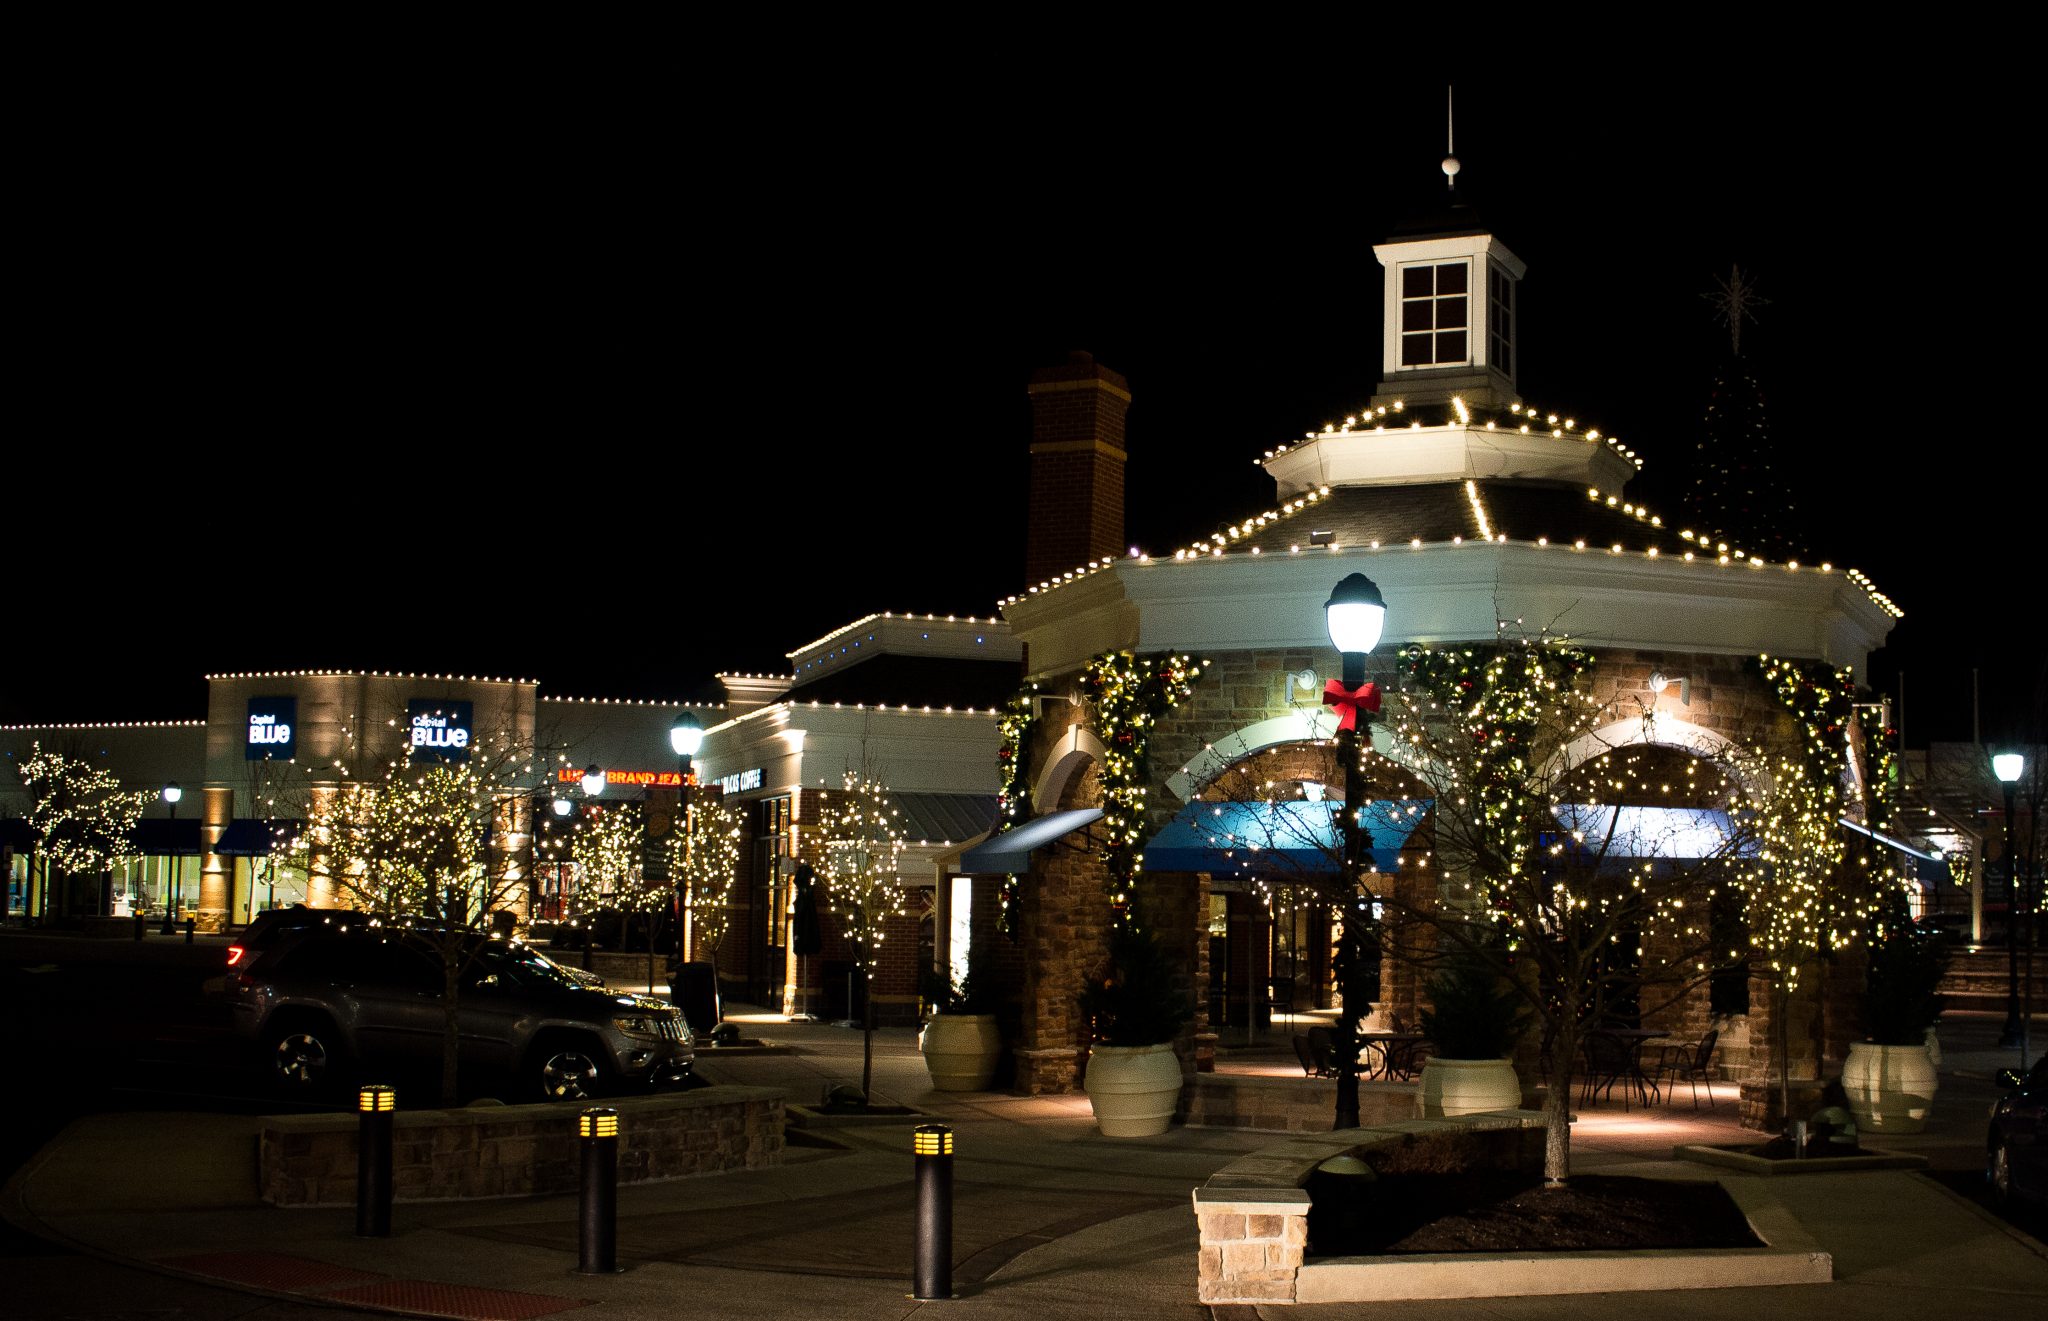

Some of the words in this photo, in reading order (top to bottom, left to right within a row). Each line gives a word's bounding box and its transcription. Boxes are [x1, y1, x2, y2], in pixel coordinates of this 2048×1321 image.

[412, 716, 446, 728] Capital
[606, 770, 656, 785] BRAND
[740, 768, 761, 792] COFFEE
